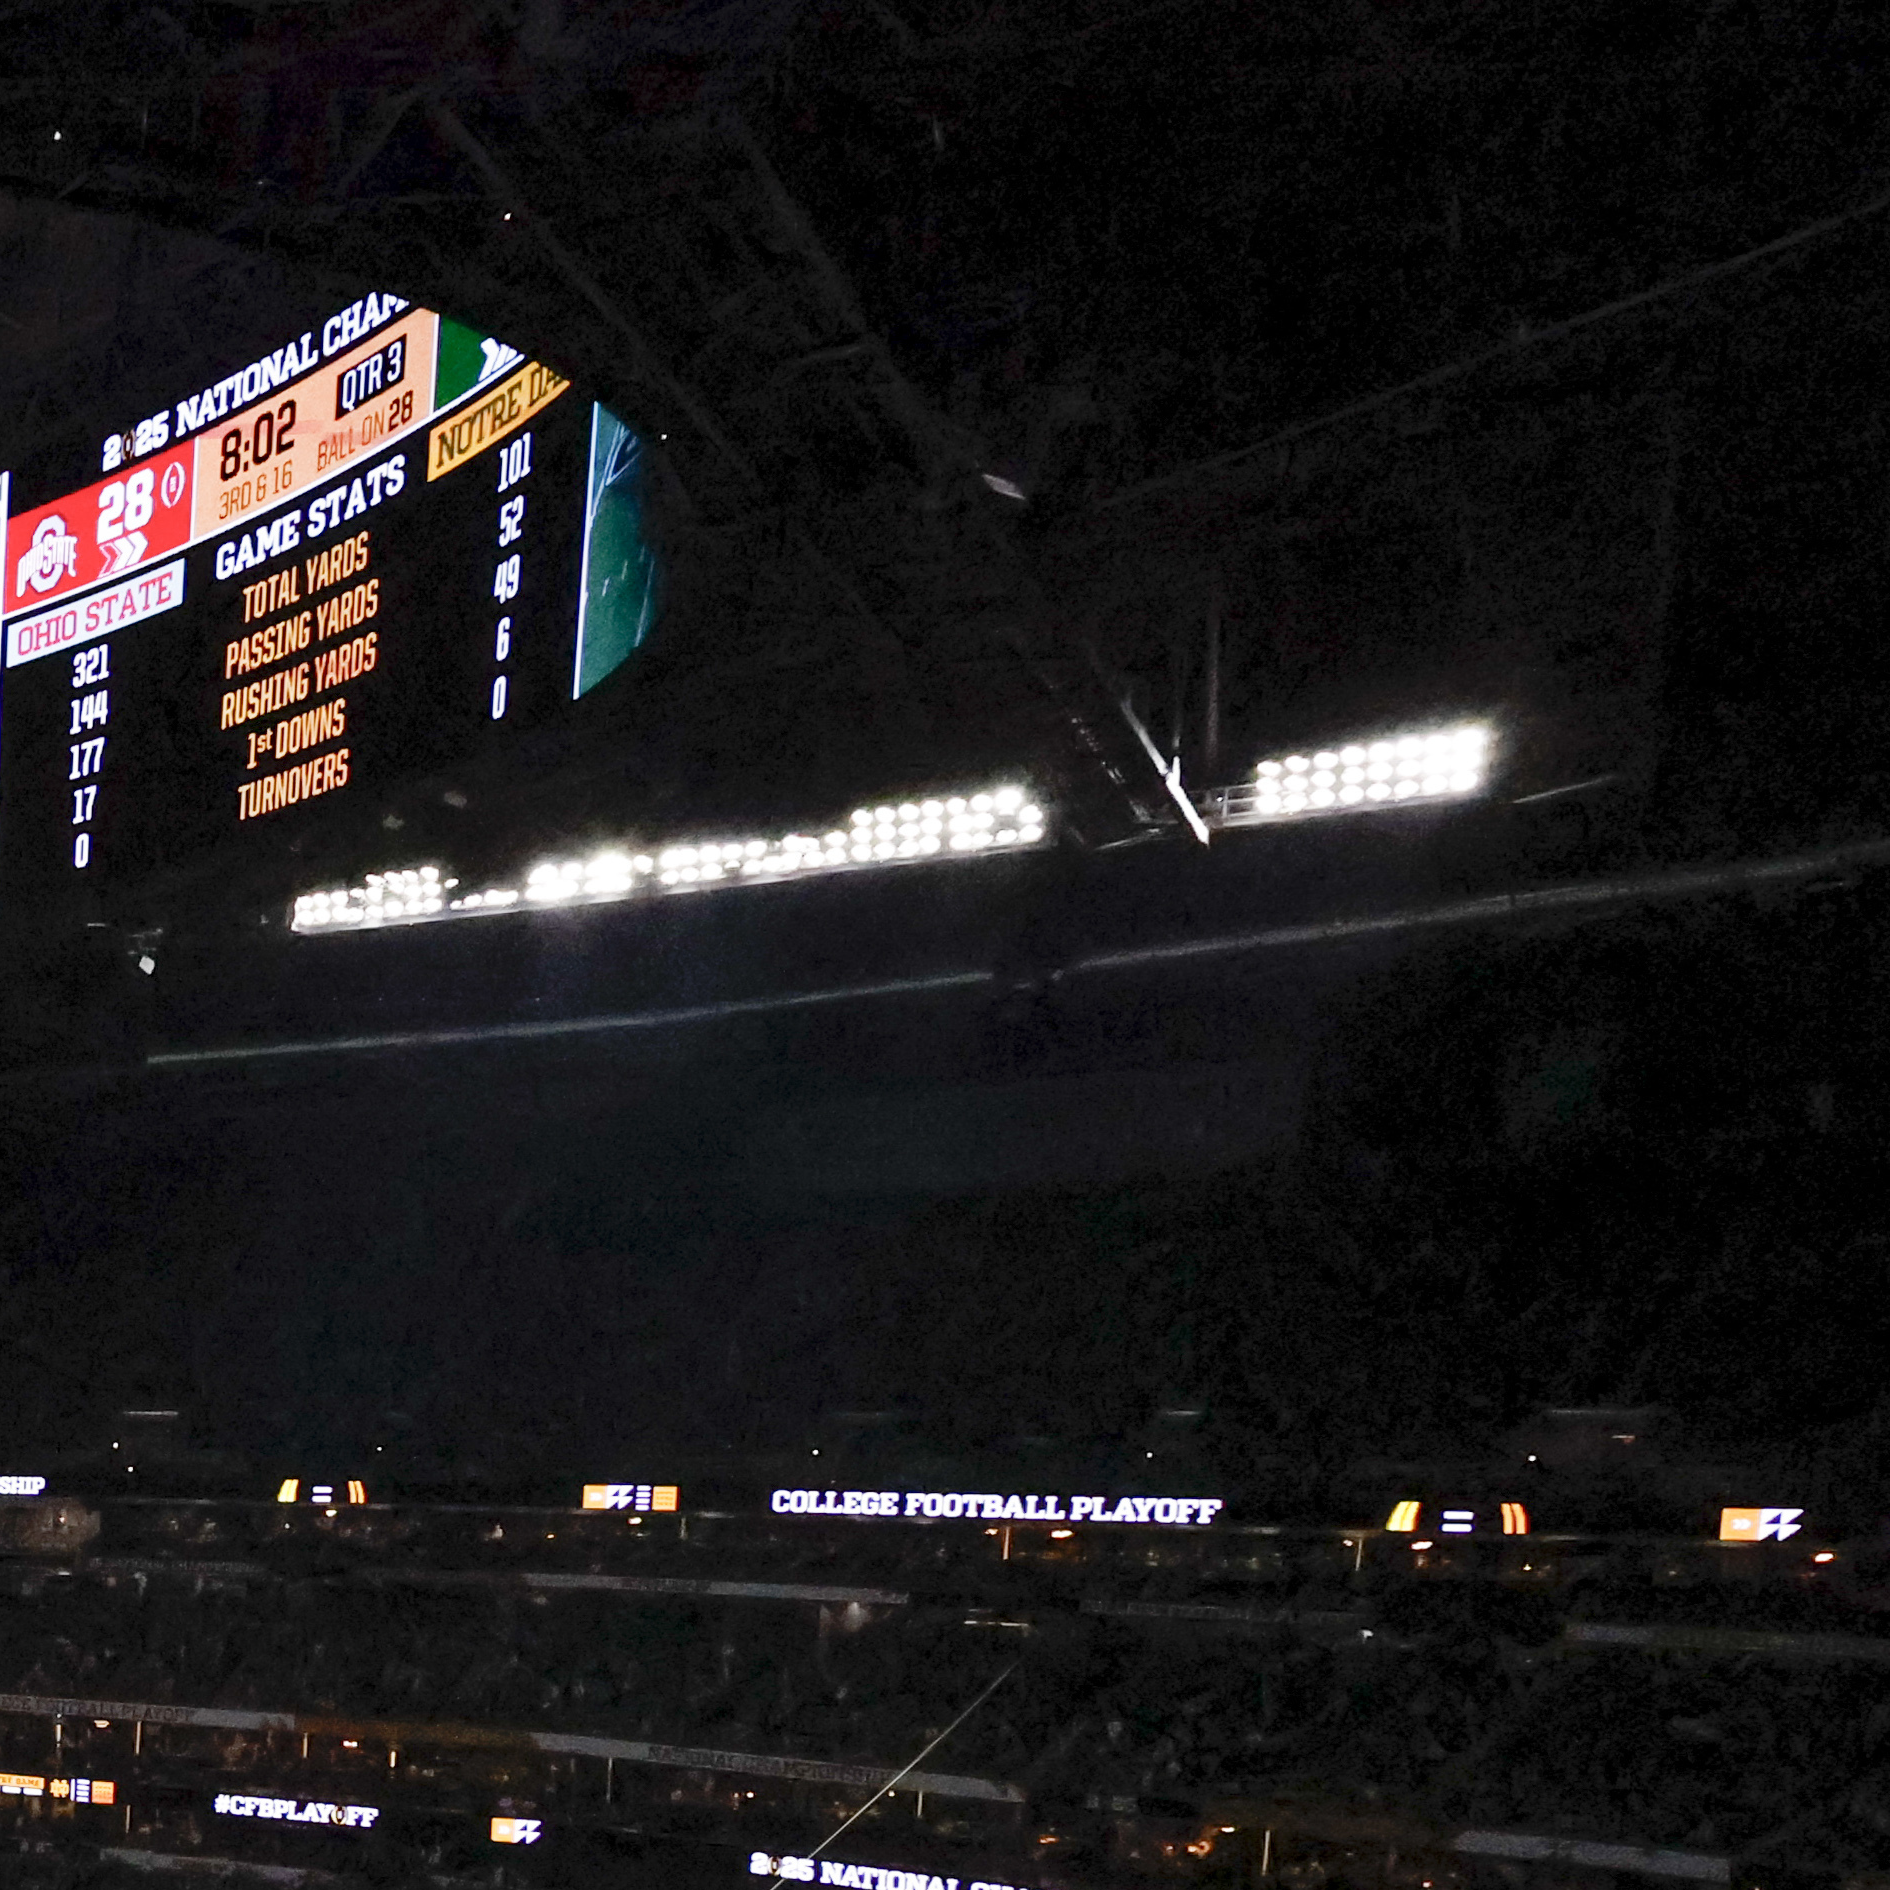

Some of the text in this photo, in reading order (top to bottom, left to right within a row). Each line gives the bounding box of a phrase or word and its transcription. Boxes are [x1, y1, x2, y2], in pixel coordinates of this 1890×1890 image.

[175, 331, 319, 437] NATIONAL
[220, 357, 383, 482] 8:02 QTR
[219, 390, 414, 521] 3RD 16 BALL ON 28
[435, 381, 523, 470] NOTRE
[497, 431, 532, 493] 101
[97, 467, 154, 545] 28
[215, 453, 407, 580] GAME STATS
[498, 495, 525, 548] 52
[18, 570, 172, 656] OHIO STATE
[242, 530, 369, 624] TOTAL YARDS
[493, 554, 521, 604] 49
[72, 643, 110, 688] 321
[225, 578, 379, 680] PASSING YARDS
[69, 690, 109, 735] 144
[221, 631, 378, 730] RUSHING YARDS
[69, 737, 105, 780] 177
[275, 698, 345, 759] DOWNS
[72, 785, 98, 825] 17
[237, 748, 350, 821] TURNOVERS
[772, 1489, 1222, 1524] COLLEGE FOOTBALL PLAYOFF
